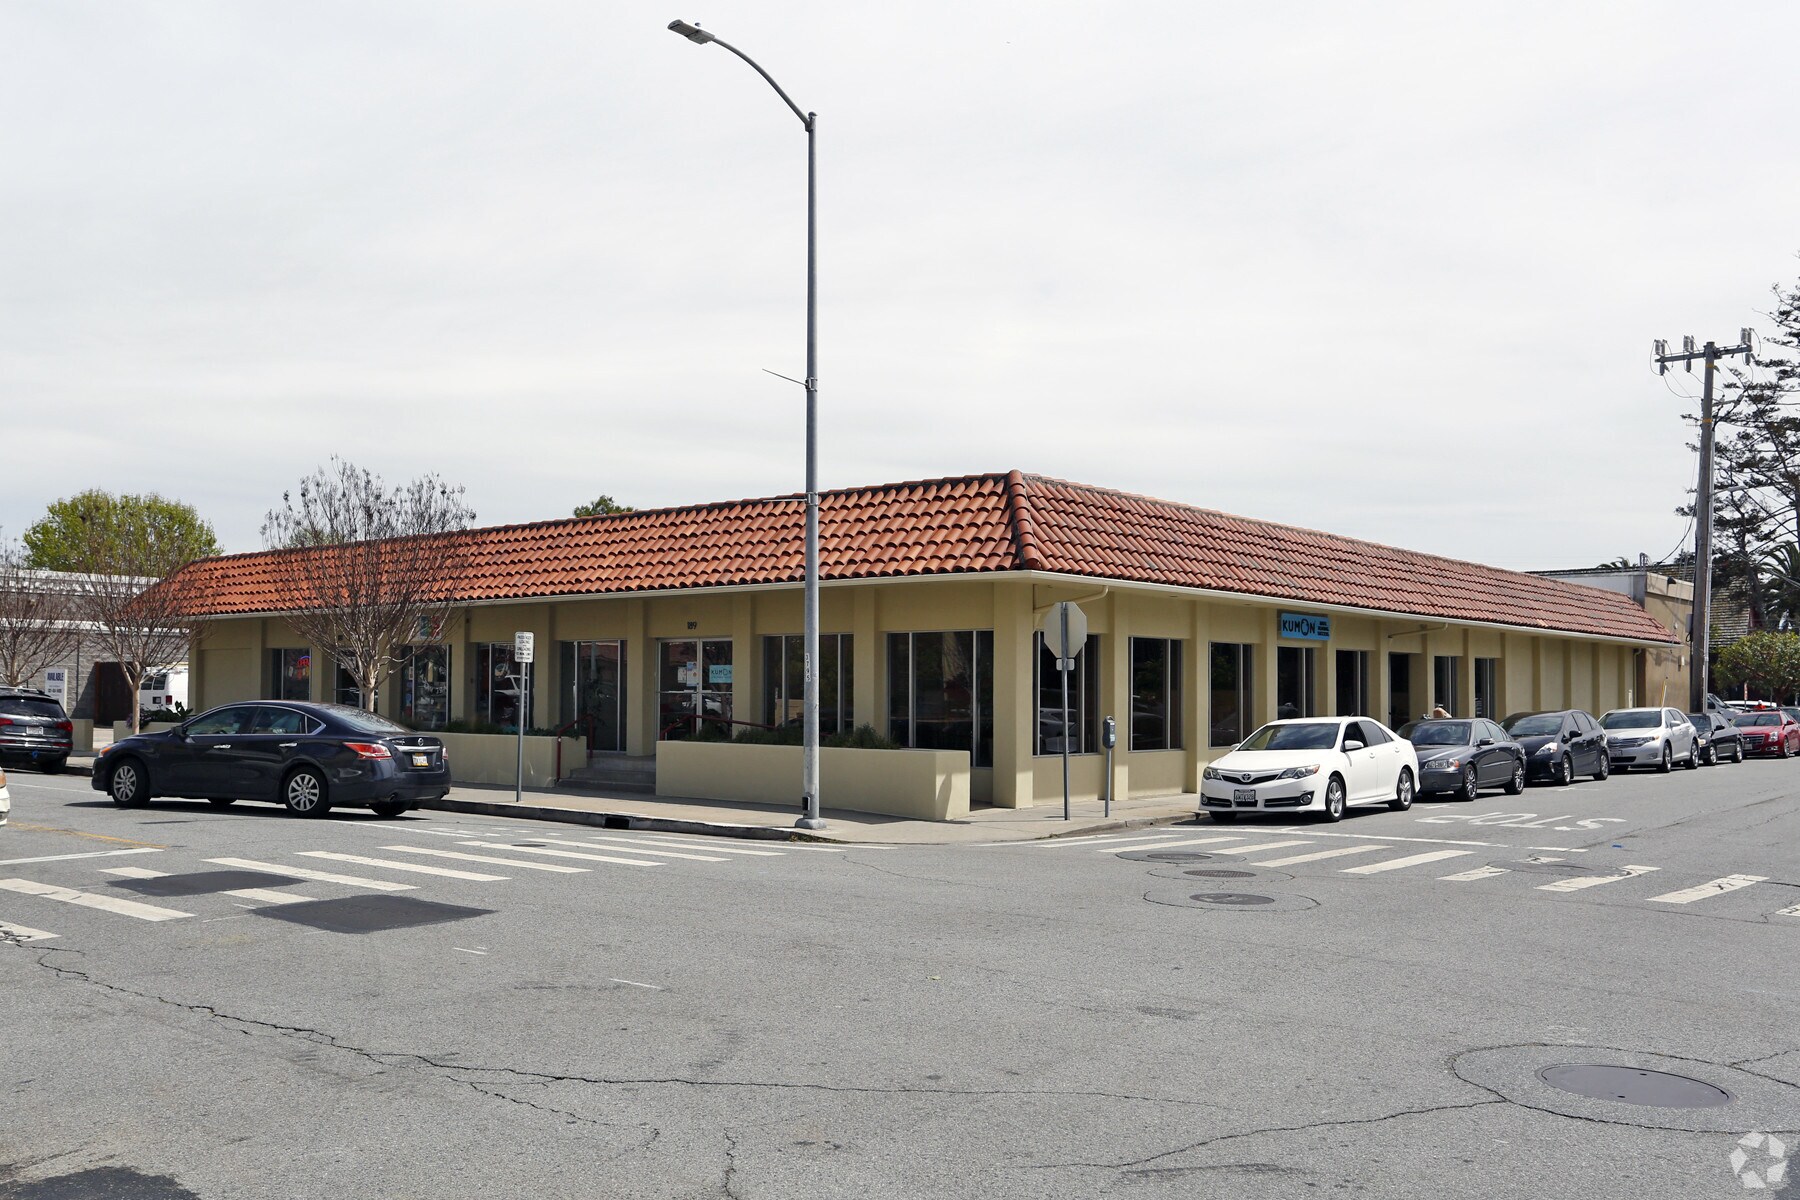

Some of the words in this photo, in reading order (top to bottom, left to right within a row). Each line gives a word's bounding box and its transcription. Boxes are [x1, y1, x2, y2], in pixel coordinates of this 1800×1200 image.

[1282, 618, 1316, 636] KUMON
[47, 672, 64, 681] AVAILABLE
[711, 668, 732, 676] KUMON
[1414, 811, 1628, 832] STOP
